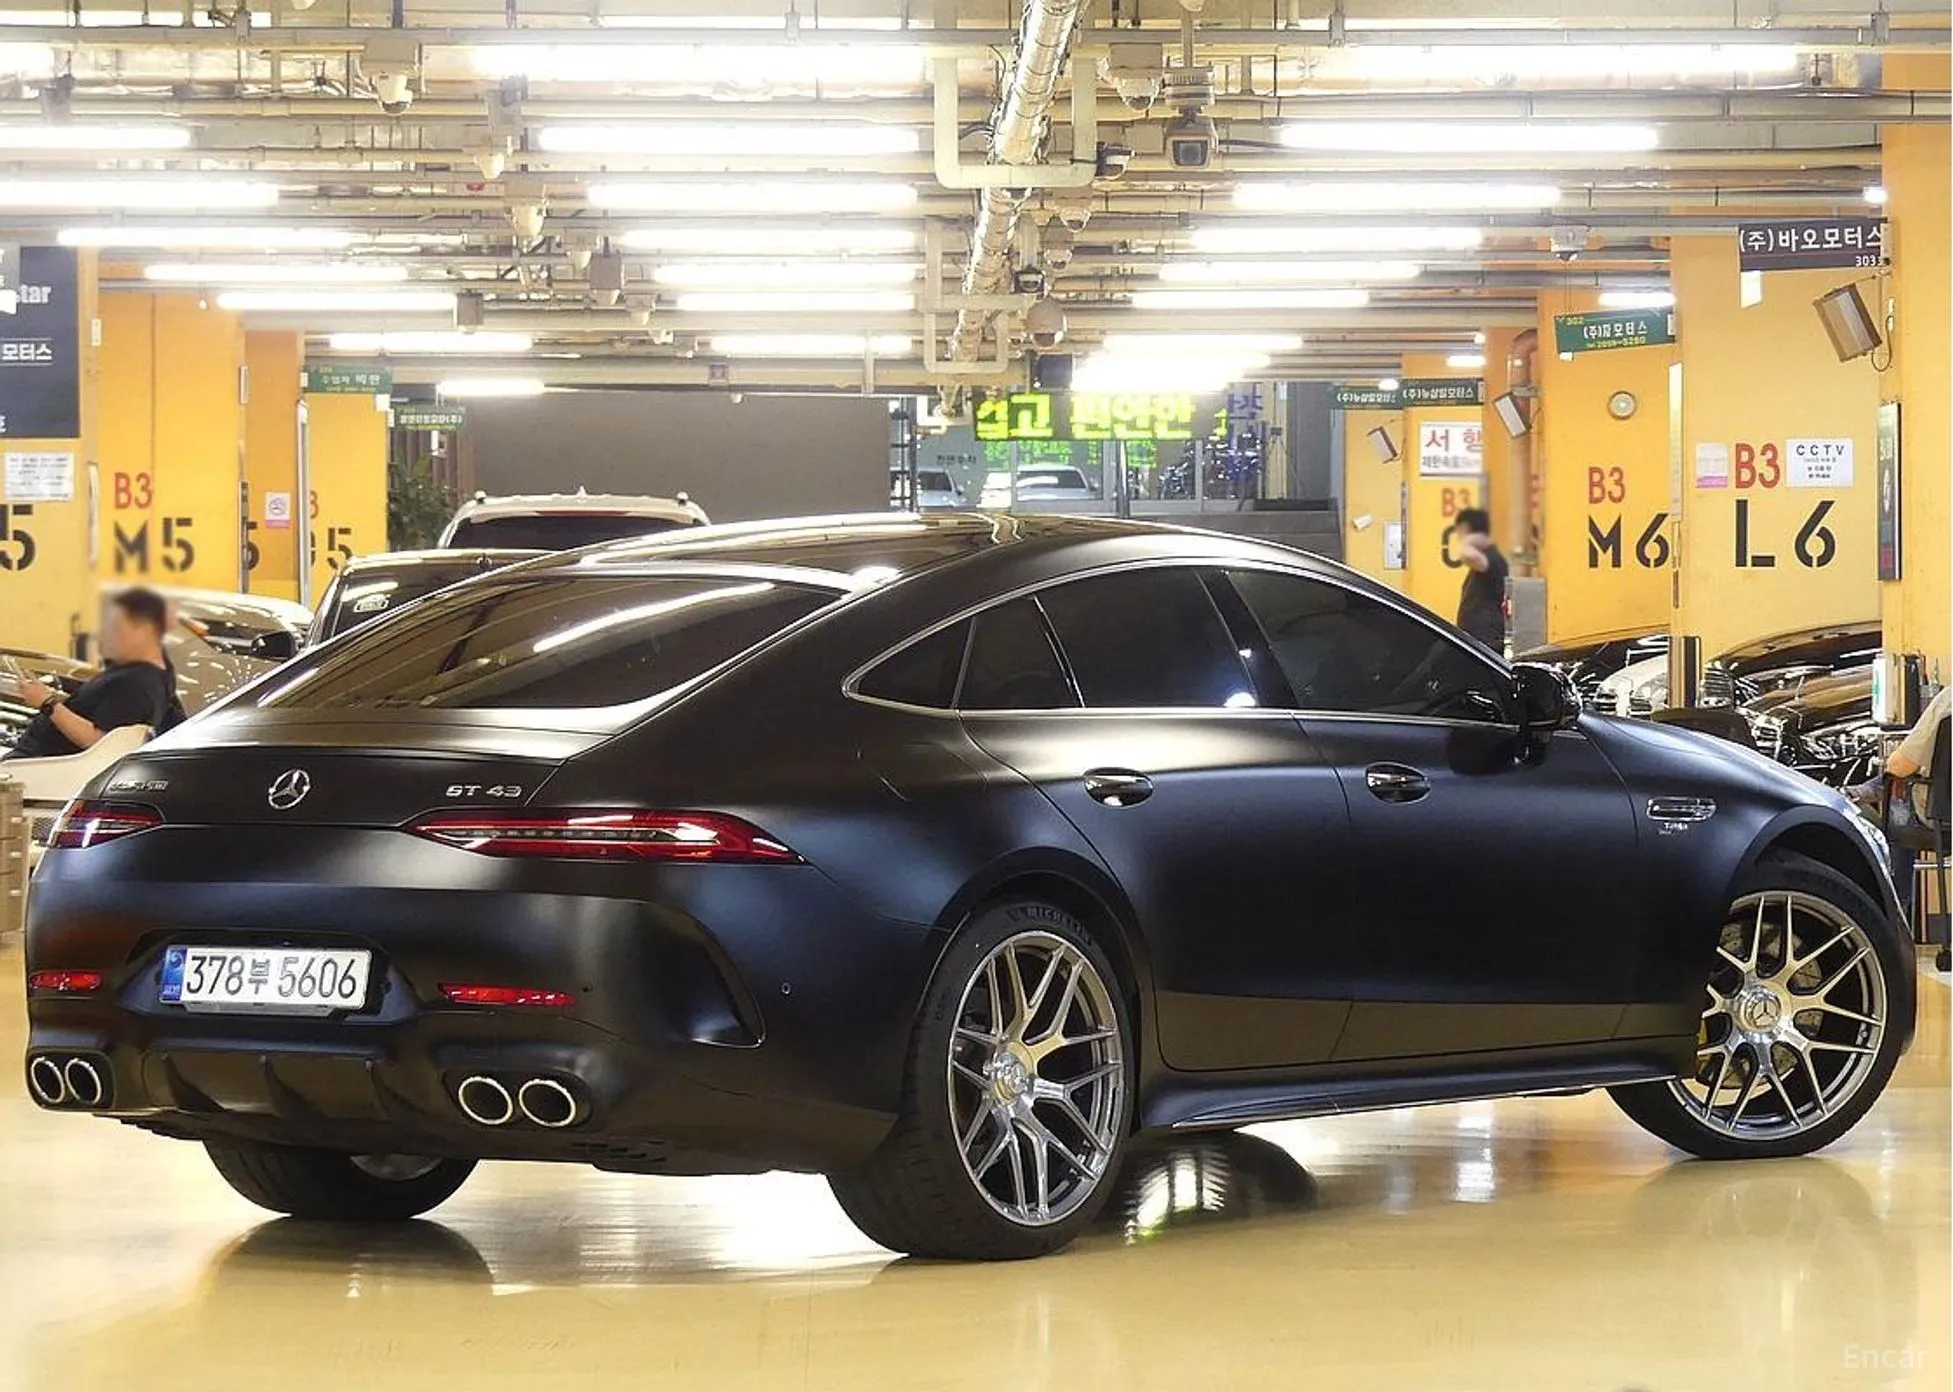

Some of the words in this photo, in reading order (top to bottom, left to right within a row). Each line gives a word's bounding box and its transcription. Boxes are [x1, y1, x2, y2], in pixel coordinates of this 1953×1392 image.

[1739, 226, 1881, 252] (주)바오모터스
[1736, 443, 1781, 489] B3
[114, 472, 152, 509] B3
[1588, 467, 1626, 504] B3
[446, 785, 482, 797] GT
[486, 785, 522, 797] 43
[187, 955, 271, 995] 378부
[278, 956, 357, 999] 5606
